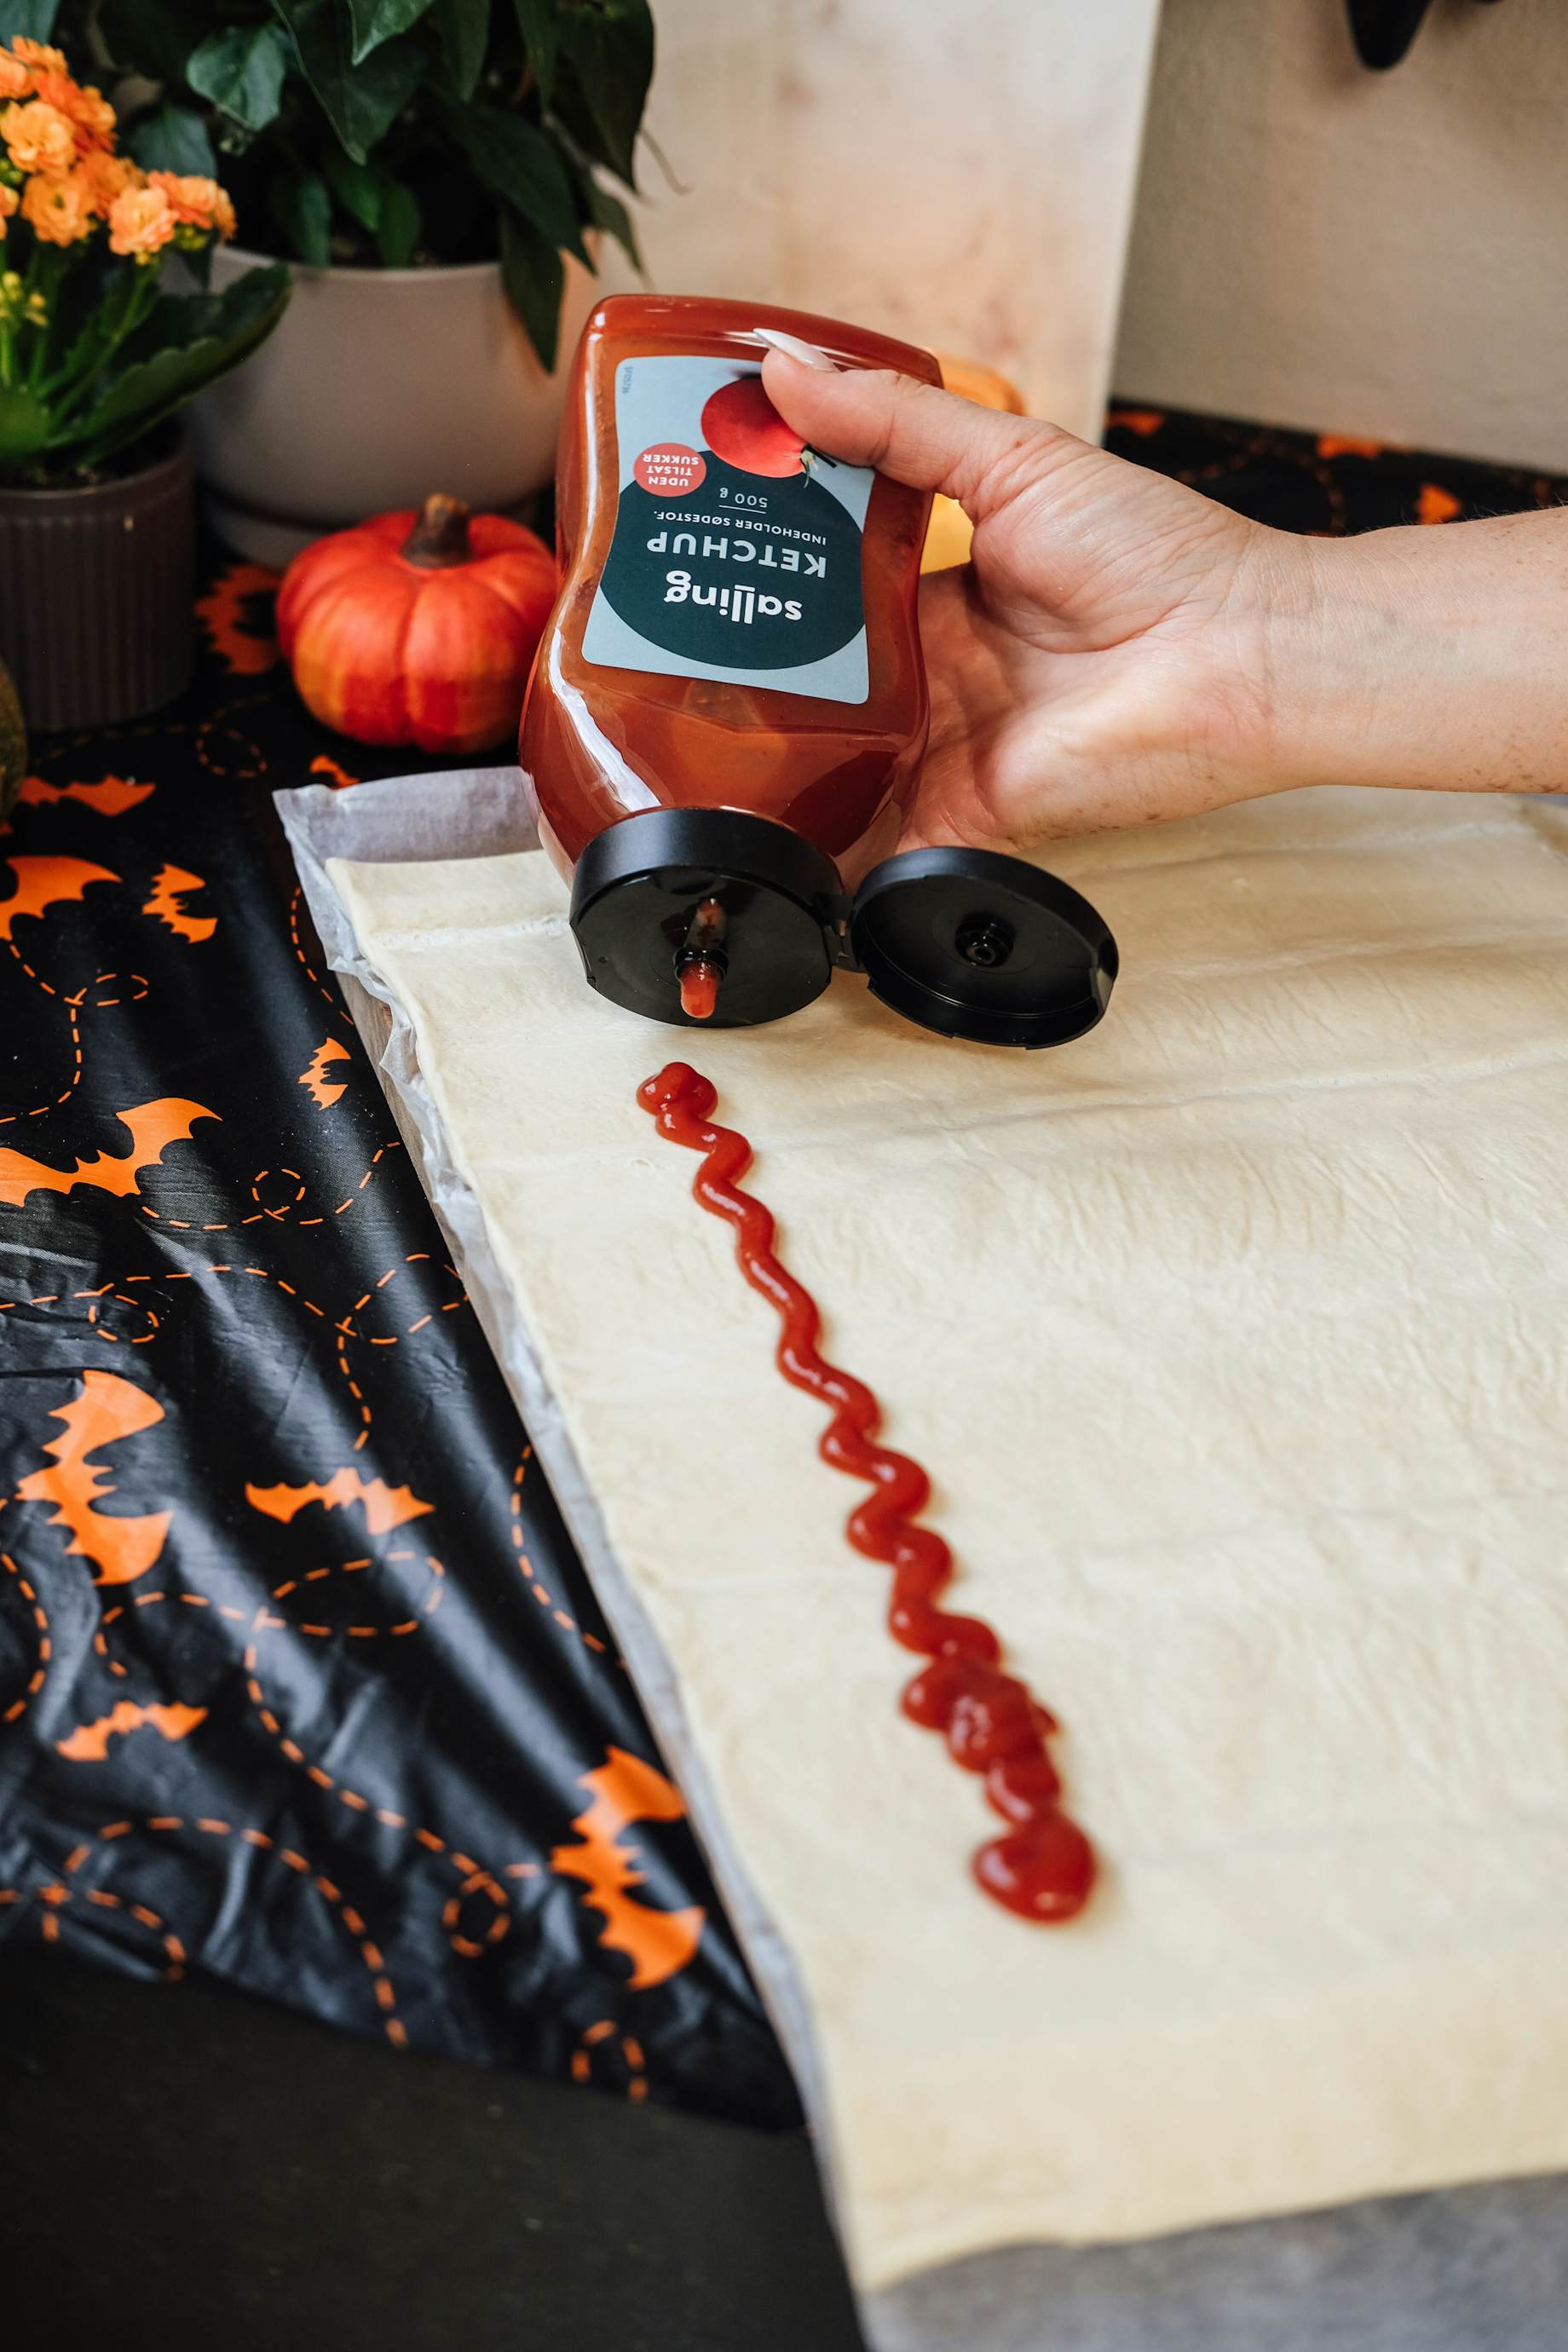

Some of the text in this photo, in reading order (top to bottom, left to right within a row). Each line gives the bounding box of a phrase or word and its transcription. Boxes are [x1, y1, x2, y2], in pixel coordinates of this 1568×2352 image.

[643, 453, 700, 465] SUKKER
[646, 465, 693, 476] TILSAT
[648, 476, 689, 487] UDEN
[719, 487, 768, 508] 500 g
[654, 511, 827, 545] INDEHOLDER SØDESTOF.
[646, 531, 827, 579] KETCHUP
[663, 570, 803, 625] salling
